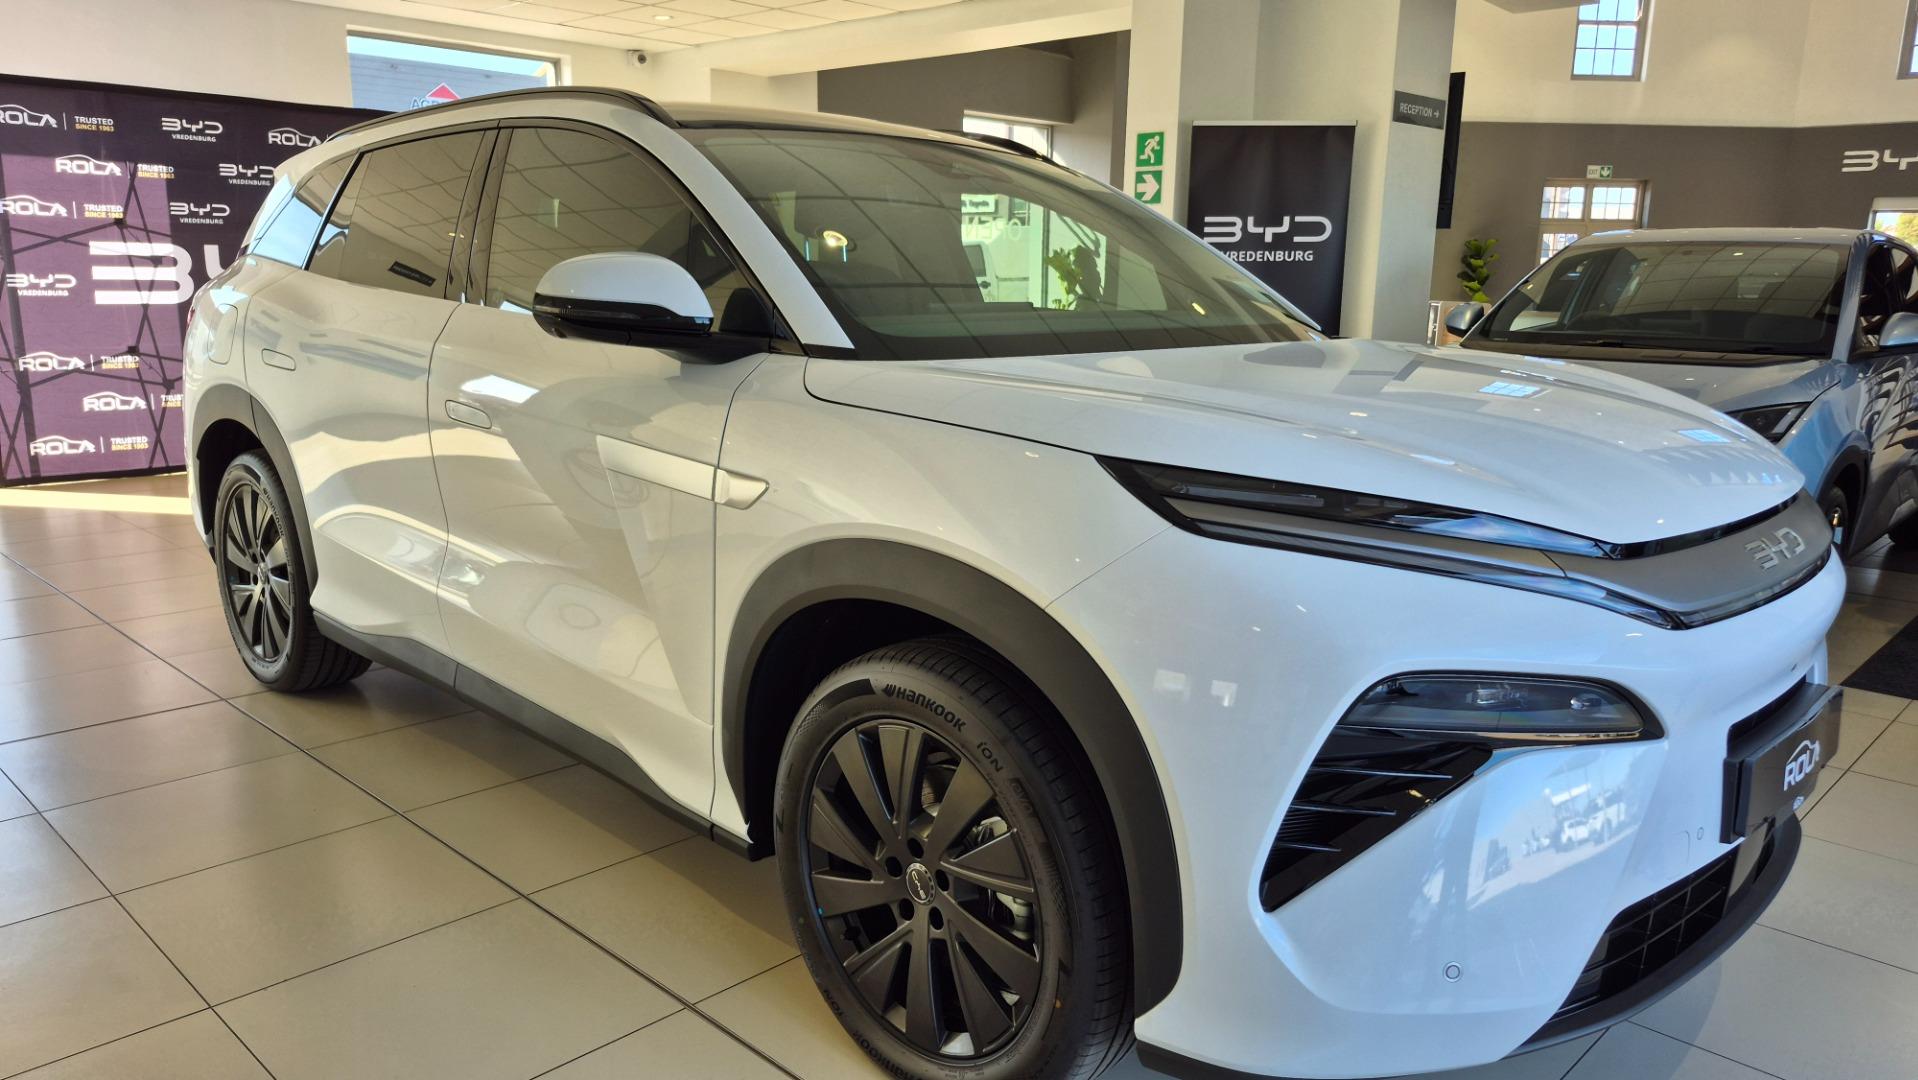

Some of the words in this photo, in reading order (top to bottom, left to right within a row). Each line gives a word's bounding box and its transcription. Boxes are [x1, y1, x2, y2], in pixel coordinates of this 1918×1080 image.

[1400, 102, 1433, 118] RECEPTION
[74, 115, 114, 126] TRUSTED
[75, 123, 97, 131] SINCE
[162, 117, 223, 134] BYD
[172, 134, 217, 143] VREDENBURG
[268, 131, 322, 147] ROLA
[56, 159, 122, 176] ROLA
[137, 164, 174, 173] TRUSTED
[219, 163, 275, 178] BYD
[228, 179, 271, 187] VREDENBURG
[0, 200, 68, 217] ROLA
[83, 203, 124, 212] TRUSTED
[170, 202, 230, 217] BYD
[180, 217, 224, 225] VREDENBURG
[1204, 216, 1332, 243] BYD
[6, 273, 77, 289] BYD
[17, 288, 69, 297] VREDENBURG
[19, 356, 85, 372] ROLA
[101, 355, 140, 364] TRUSTED
[83, 396, 147, 412] ROLA
[30, 439, 96, 456] ROLA
[111, 436, 149, 445] TRUSTED
[1744, 528, 1806, 571] BYD
[1783, 740, 1820, 791] ROLA
